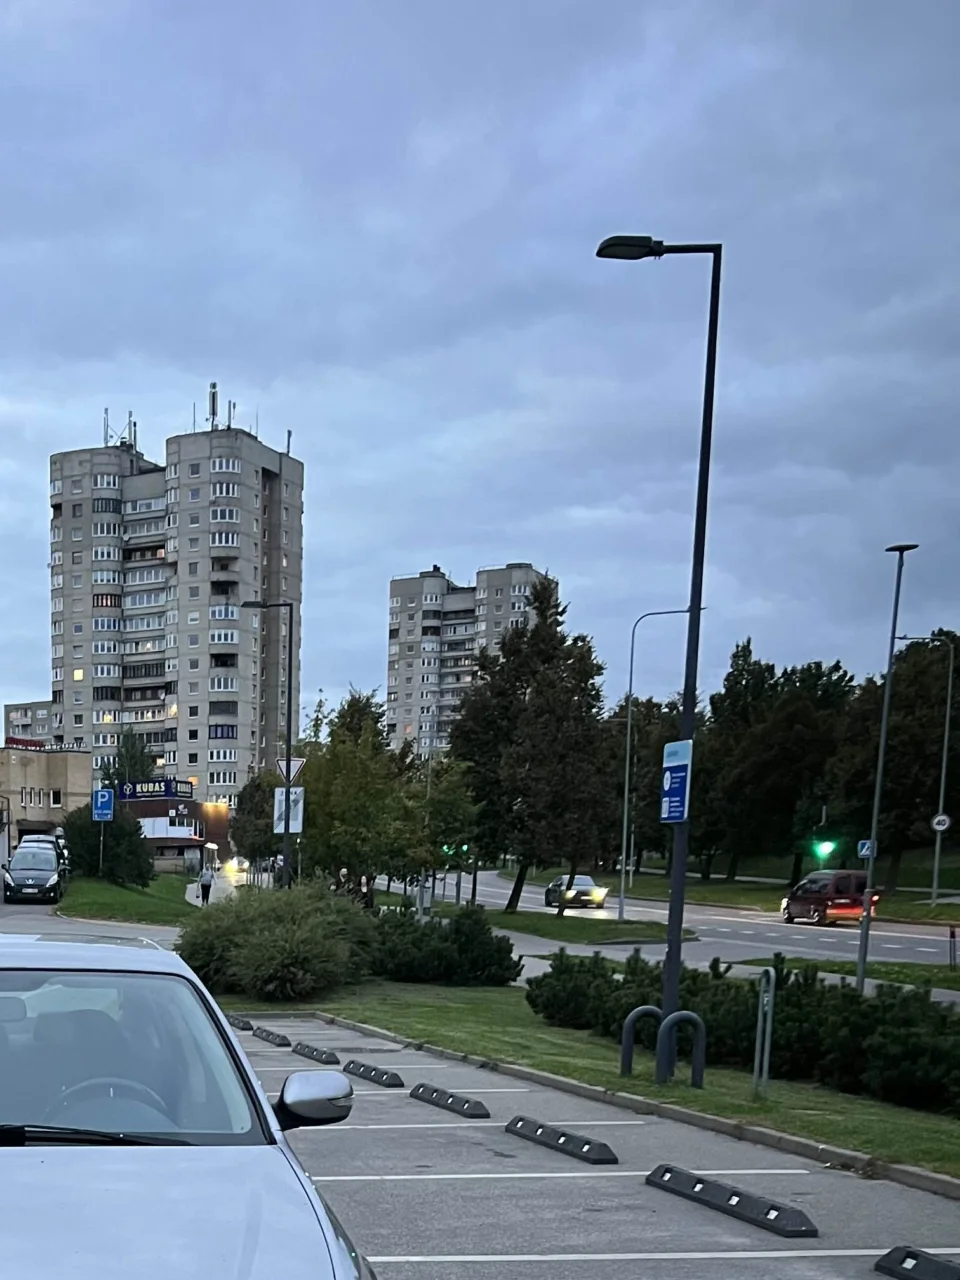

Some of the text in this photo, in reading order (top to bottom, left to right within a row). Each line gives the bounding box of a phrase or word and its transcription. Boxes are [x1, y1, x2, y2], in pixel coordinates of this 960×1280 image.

[136, 782, 165, 792] KUBAS
[97, 791, 109, 808] P
[935, 819, 947, 827] 40
